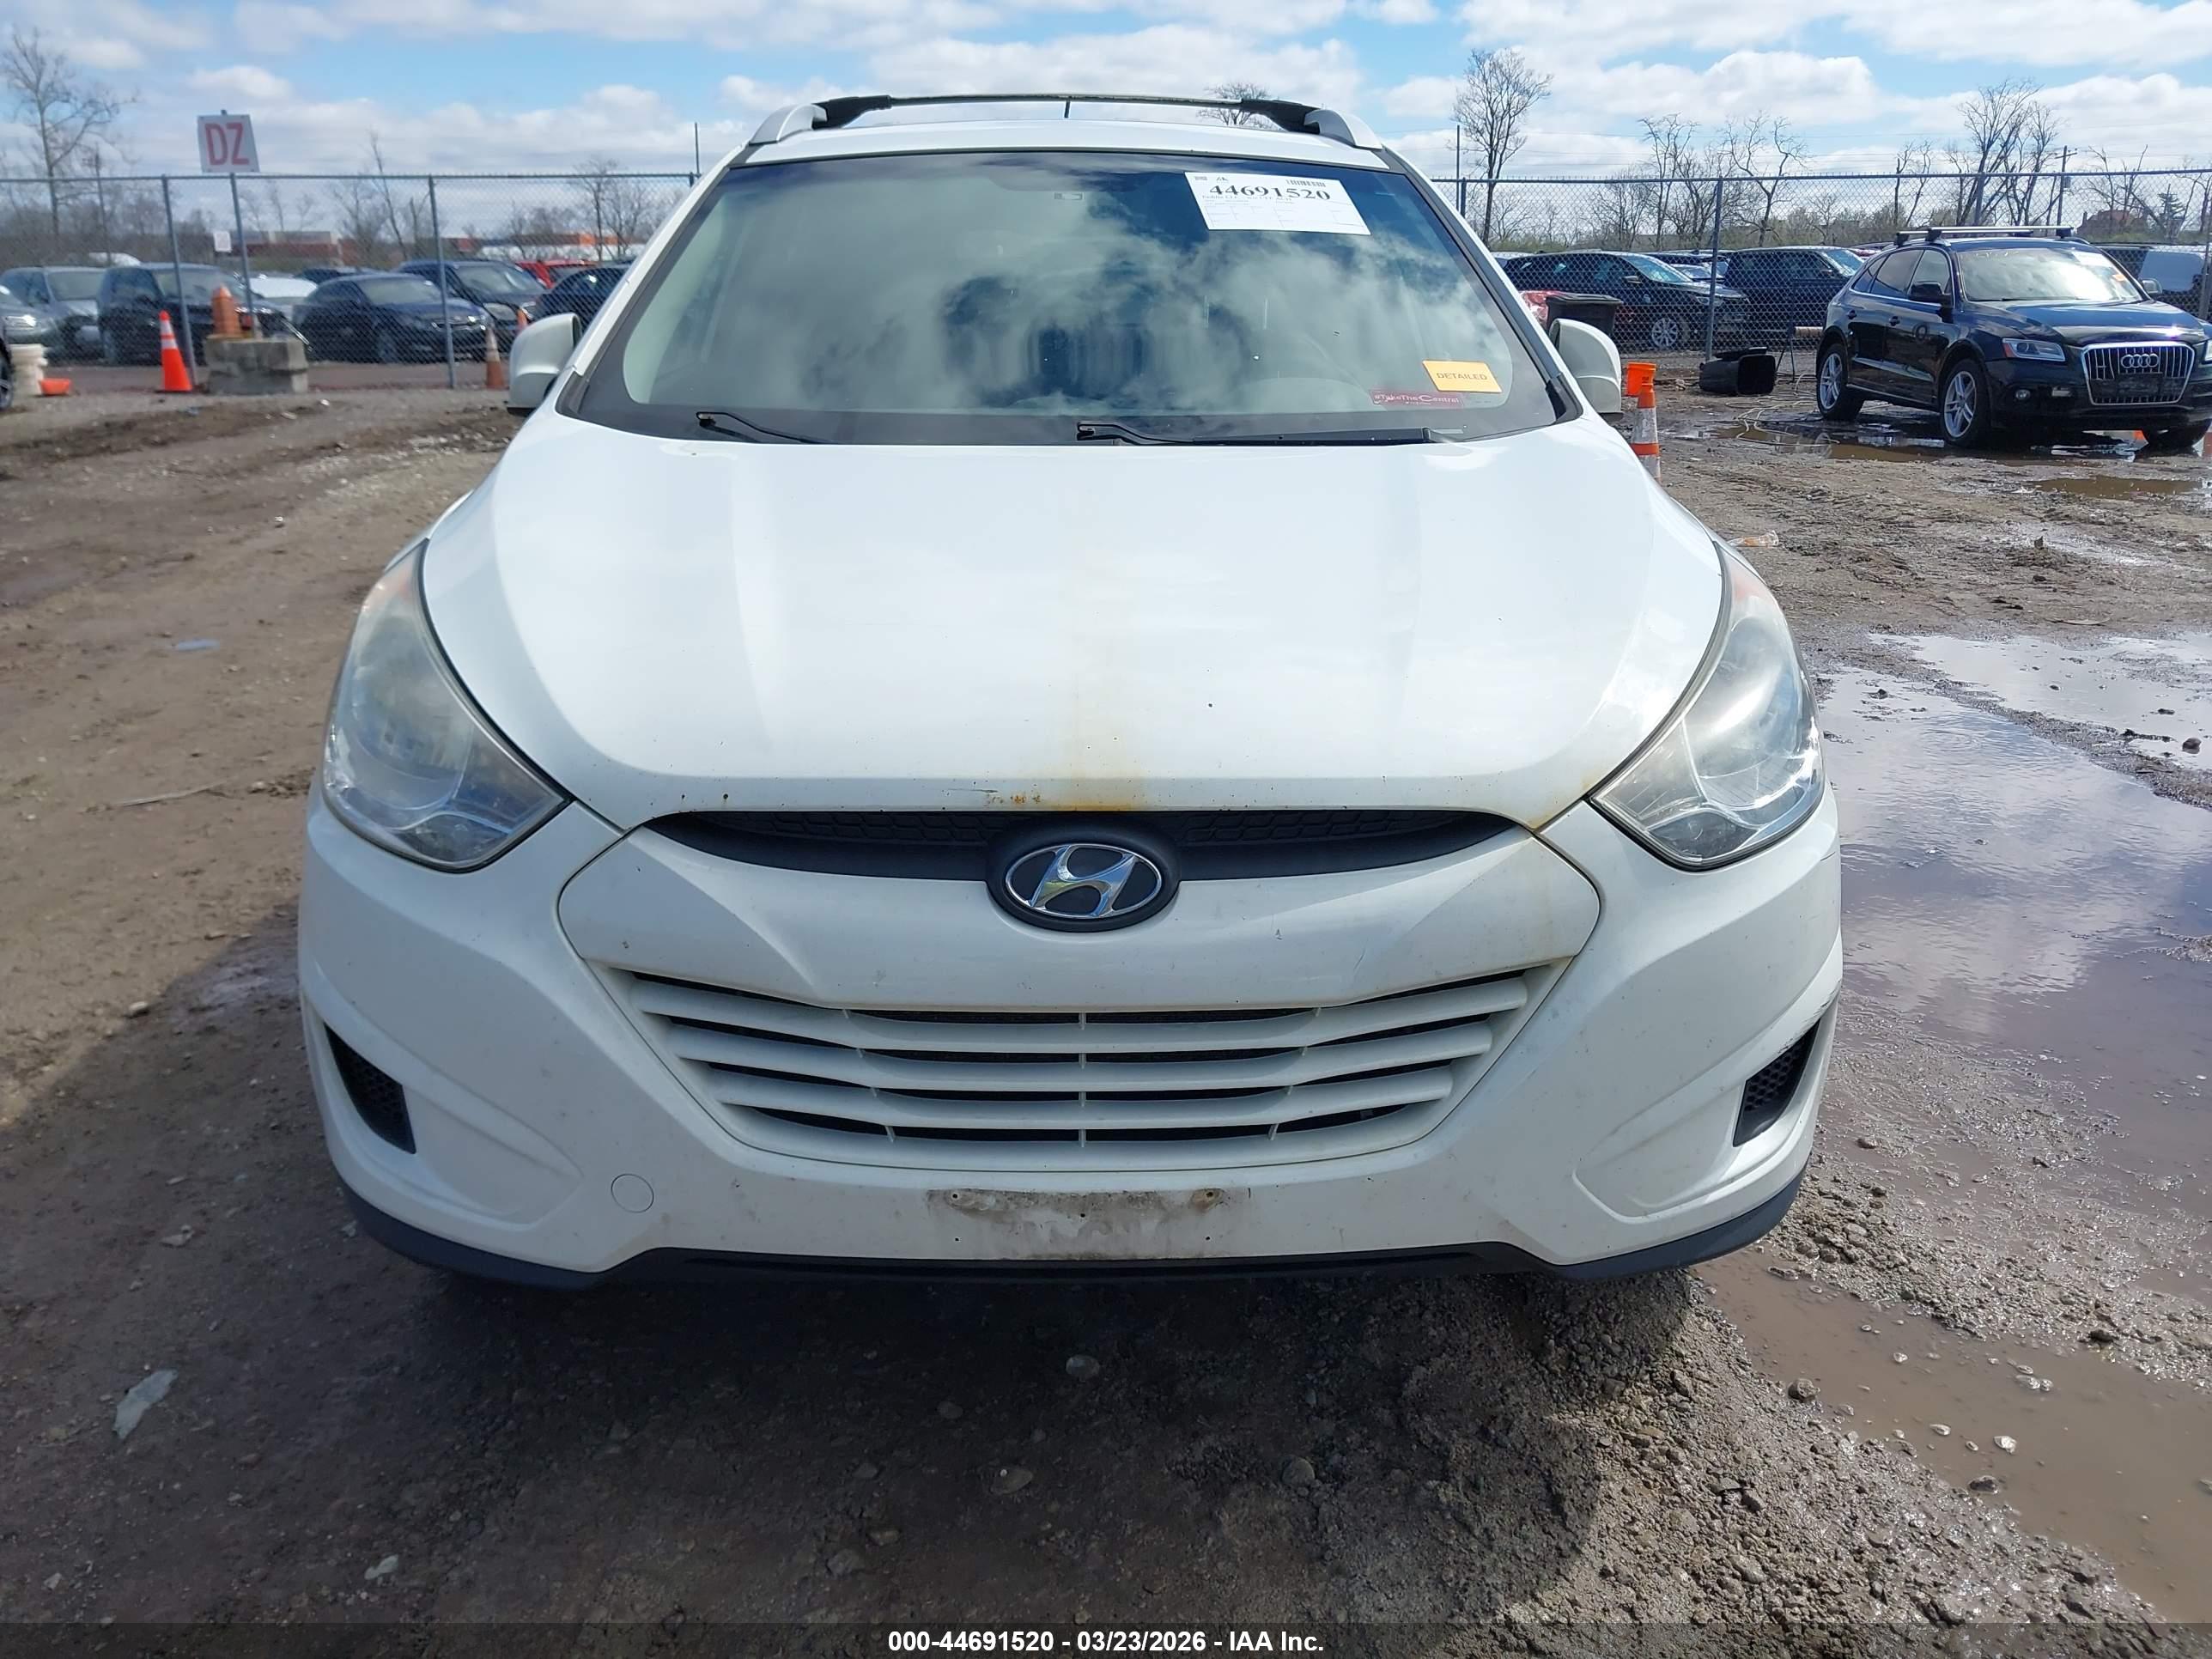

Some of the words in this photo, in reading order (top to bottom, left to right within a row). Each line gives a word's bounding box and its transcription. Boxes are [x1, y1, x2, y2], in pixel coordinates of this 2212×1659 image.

[204, 122, 249, 166] DZ
[1209, 185, 1331, 200] 44691520
[1436, 372, 1488, 380] DETAILED
